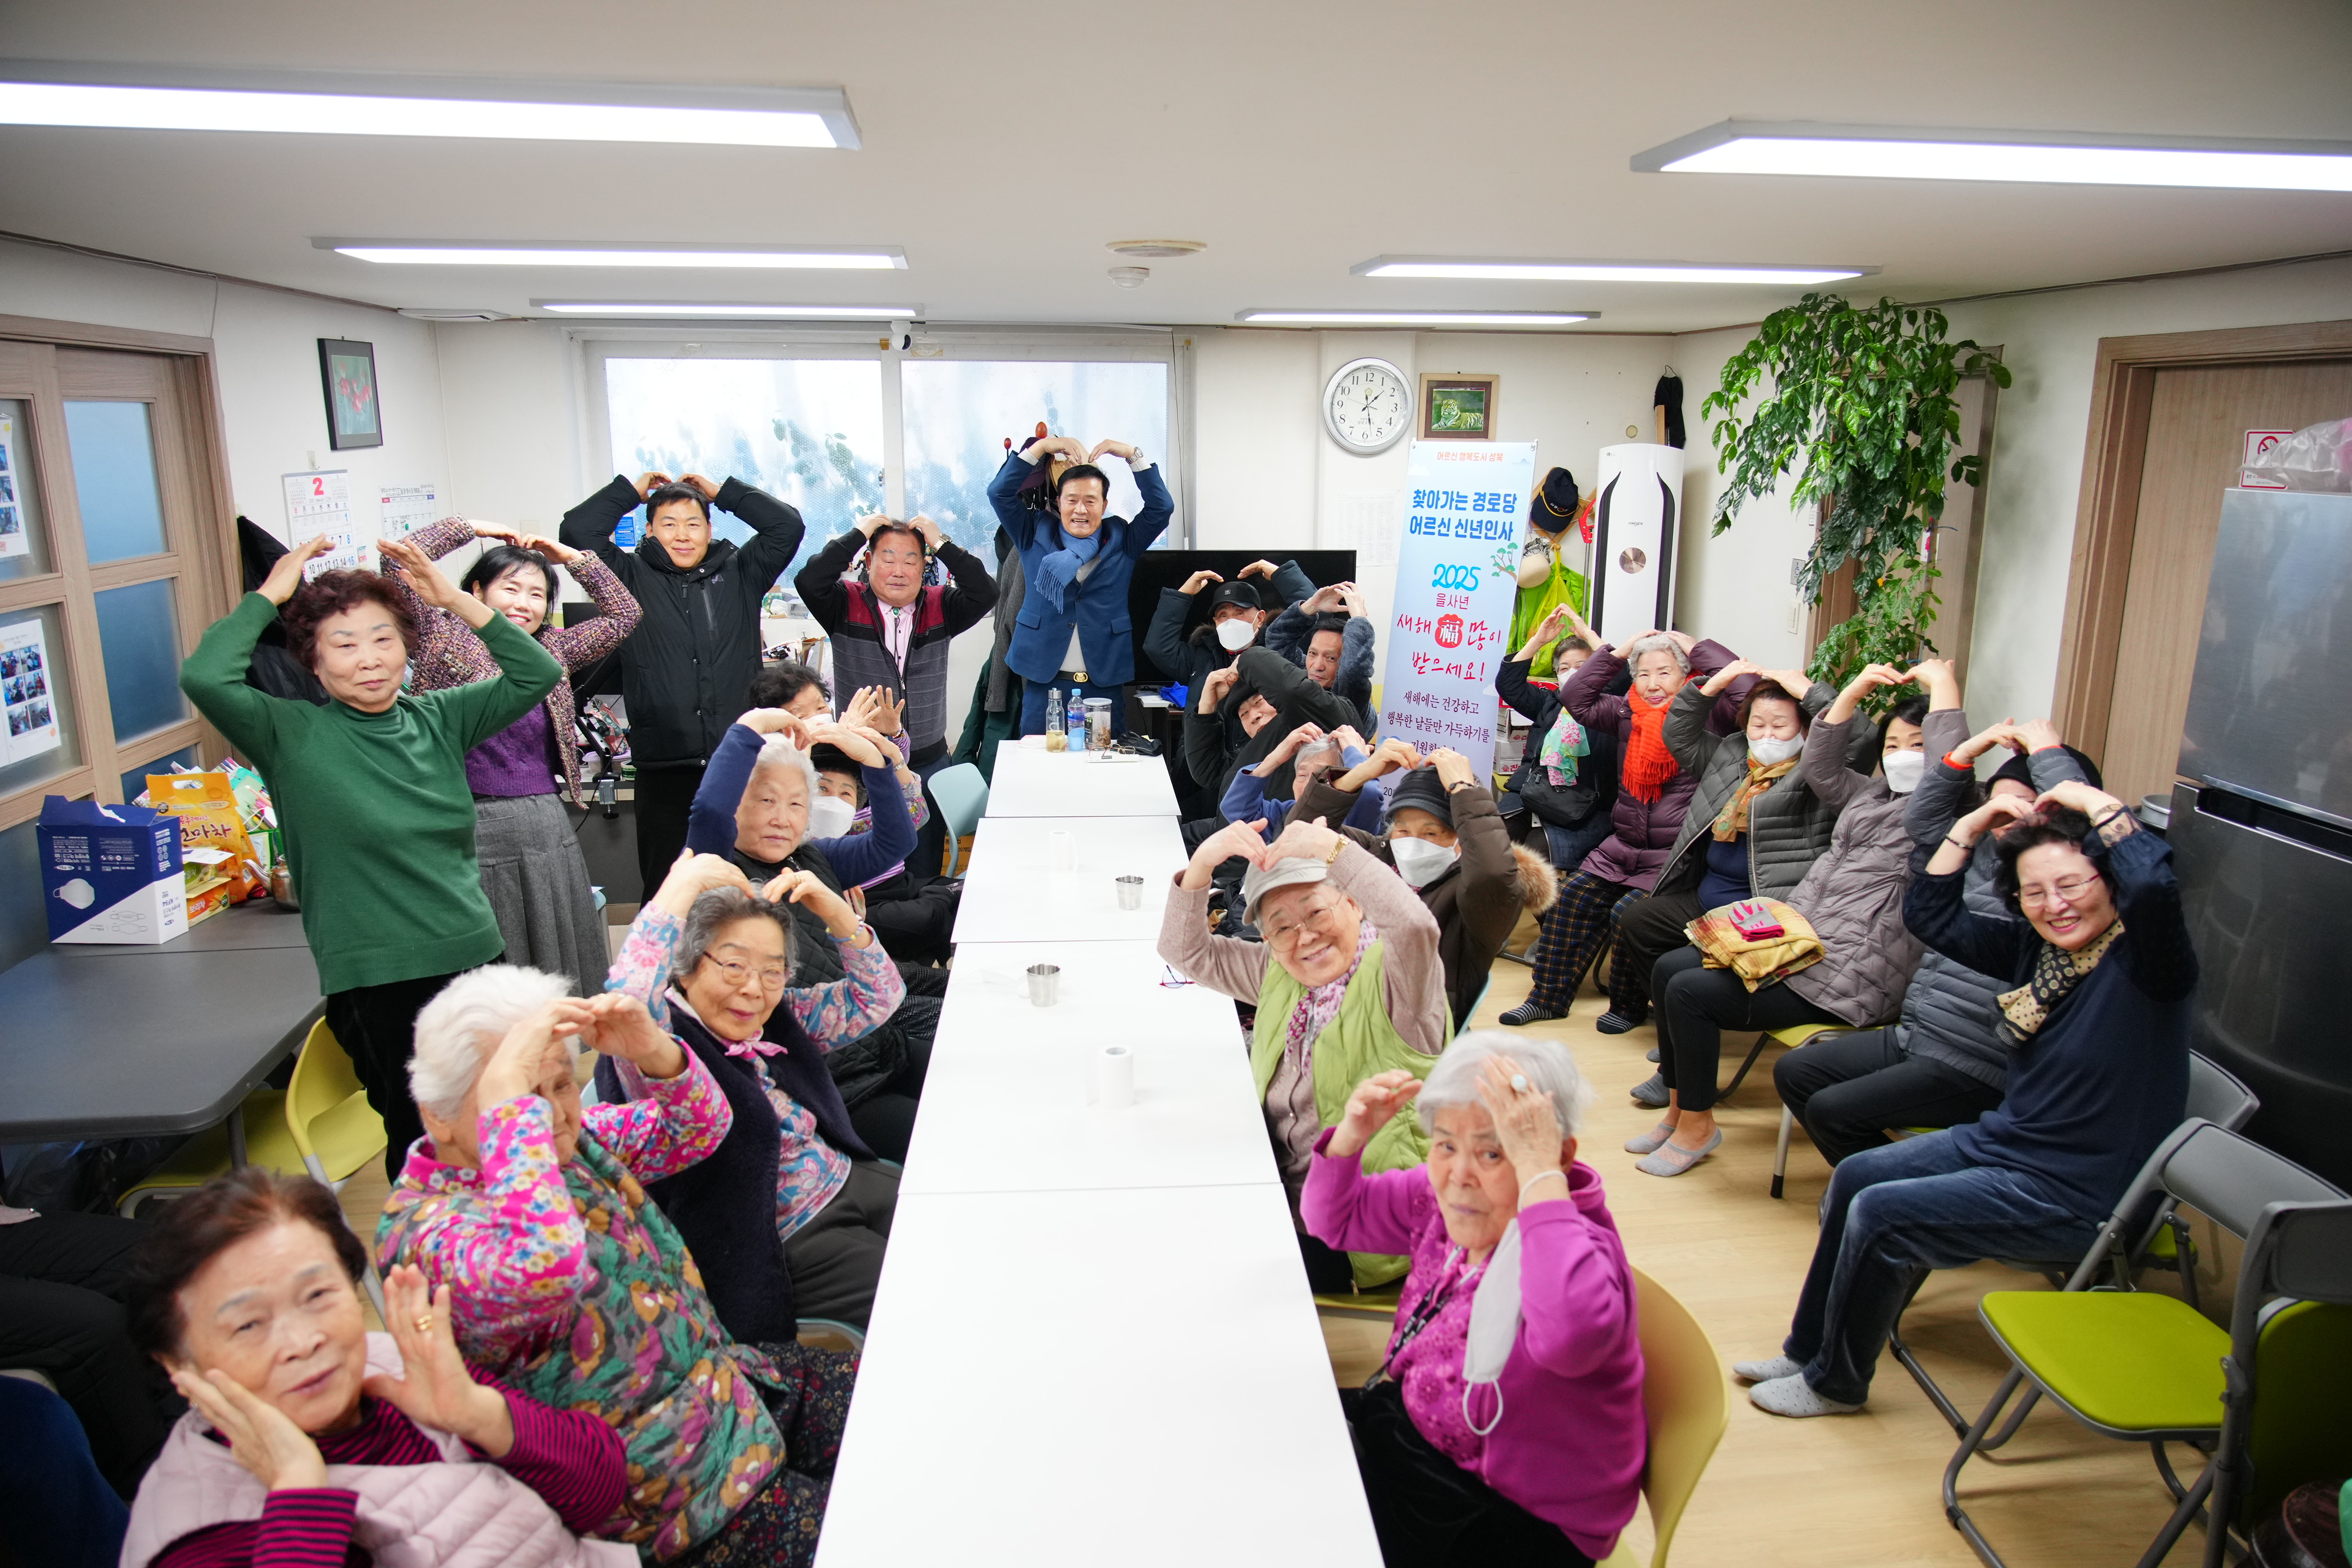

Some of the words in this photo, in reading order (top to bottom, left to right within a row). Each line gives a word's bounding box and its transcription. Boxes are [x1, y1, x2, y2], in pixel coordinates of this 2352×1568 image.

[1352, 376, 1358, 385] 11
[1365, 372, 1374, 382] 12
[1381, 377, 1384, 386] 1
[1341, 386, 1350, 396] 10
[1389, 388, 1395, 397] 2
[1337, 400, 1343, 409] 9
[1391, 403, 1398, 413] 3
[1339, 414, 1345, 424] 8
[1386, 417, 1392, 426] 4
[1349, 426, 1355, 436] 7
[1362, 431, 1368, 439] 6
[1376, 428, 1382, 437] 5
[1437, 452, 1457, 461] 어르신
[1460, 452, 1487, 461] 행복도시
[1489, 453, 1503, 462] 성북
[313, 477, 324, 495] 2
[1412, 489, 1468, 511] 찾아가는
[1472, 492, 1517, 513] 경로당
[1410, 516, 1451, 537] 어르신
[1455, 518, 1514, 541] 신년인사
[339, 535, 342, 545] 7
[347, 534, 351, 544] 8
[309, 564, 315, 574] 10
[317, 562, 323, 572] 11
[325, 561, 330, 571] 12
[333, 559, 339, 569] 13
[340, 557, 346, 566] 14
[348, 556, 354, 566] 15
[1432, 564, 1481, 591] 2025
[1436, 593, 1469, 610] 을사년
[1397, 614, 1431, 634] 새해
[1440, 620, 1462, 644] 福
[1468, 621, 1501, 651] 많이
[1413, 652, 1485, 682] 받으세요!
[1404, 690, 1440, 708] 새해에는
[1442, 697, 1479, 714] 건강하고
[1388, 712, 1412, 728] 행복한
[1416, 716, 1442, 734] 날들만
[1444, 722, 1490, 743] 가득하기를
[1411, 739, 1455, 755] 기원합
[1383, 787, 1394, 797] 20
[162, 899, 174, 907] KF94
[189, 900, 206, 913] 보리차
